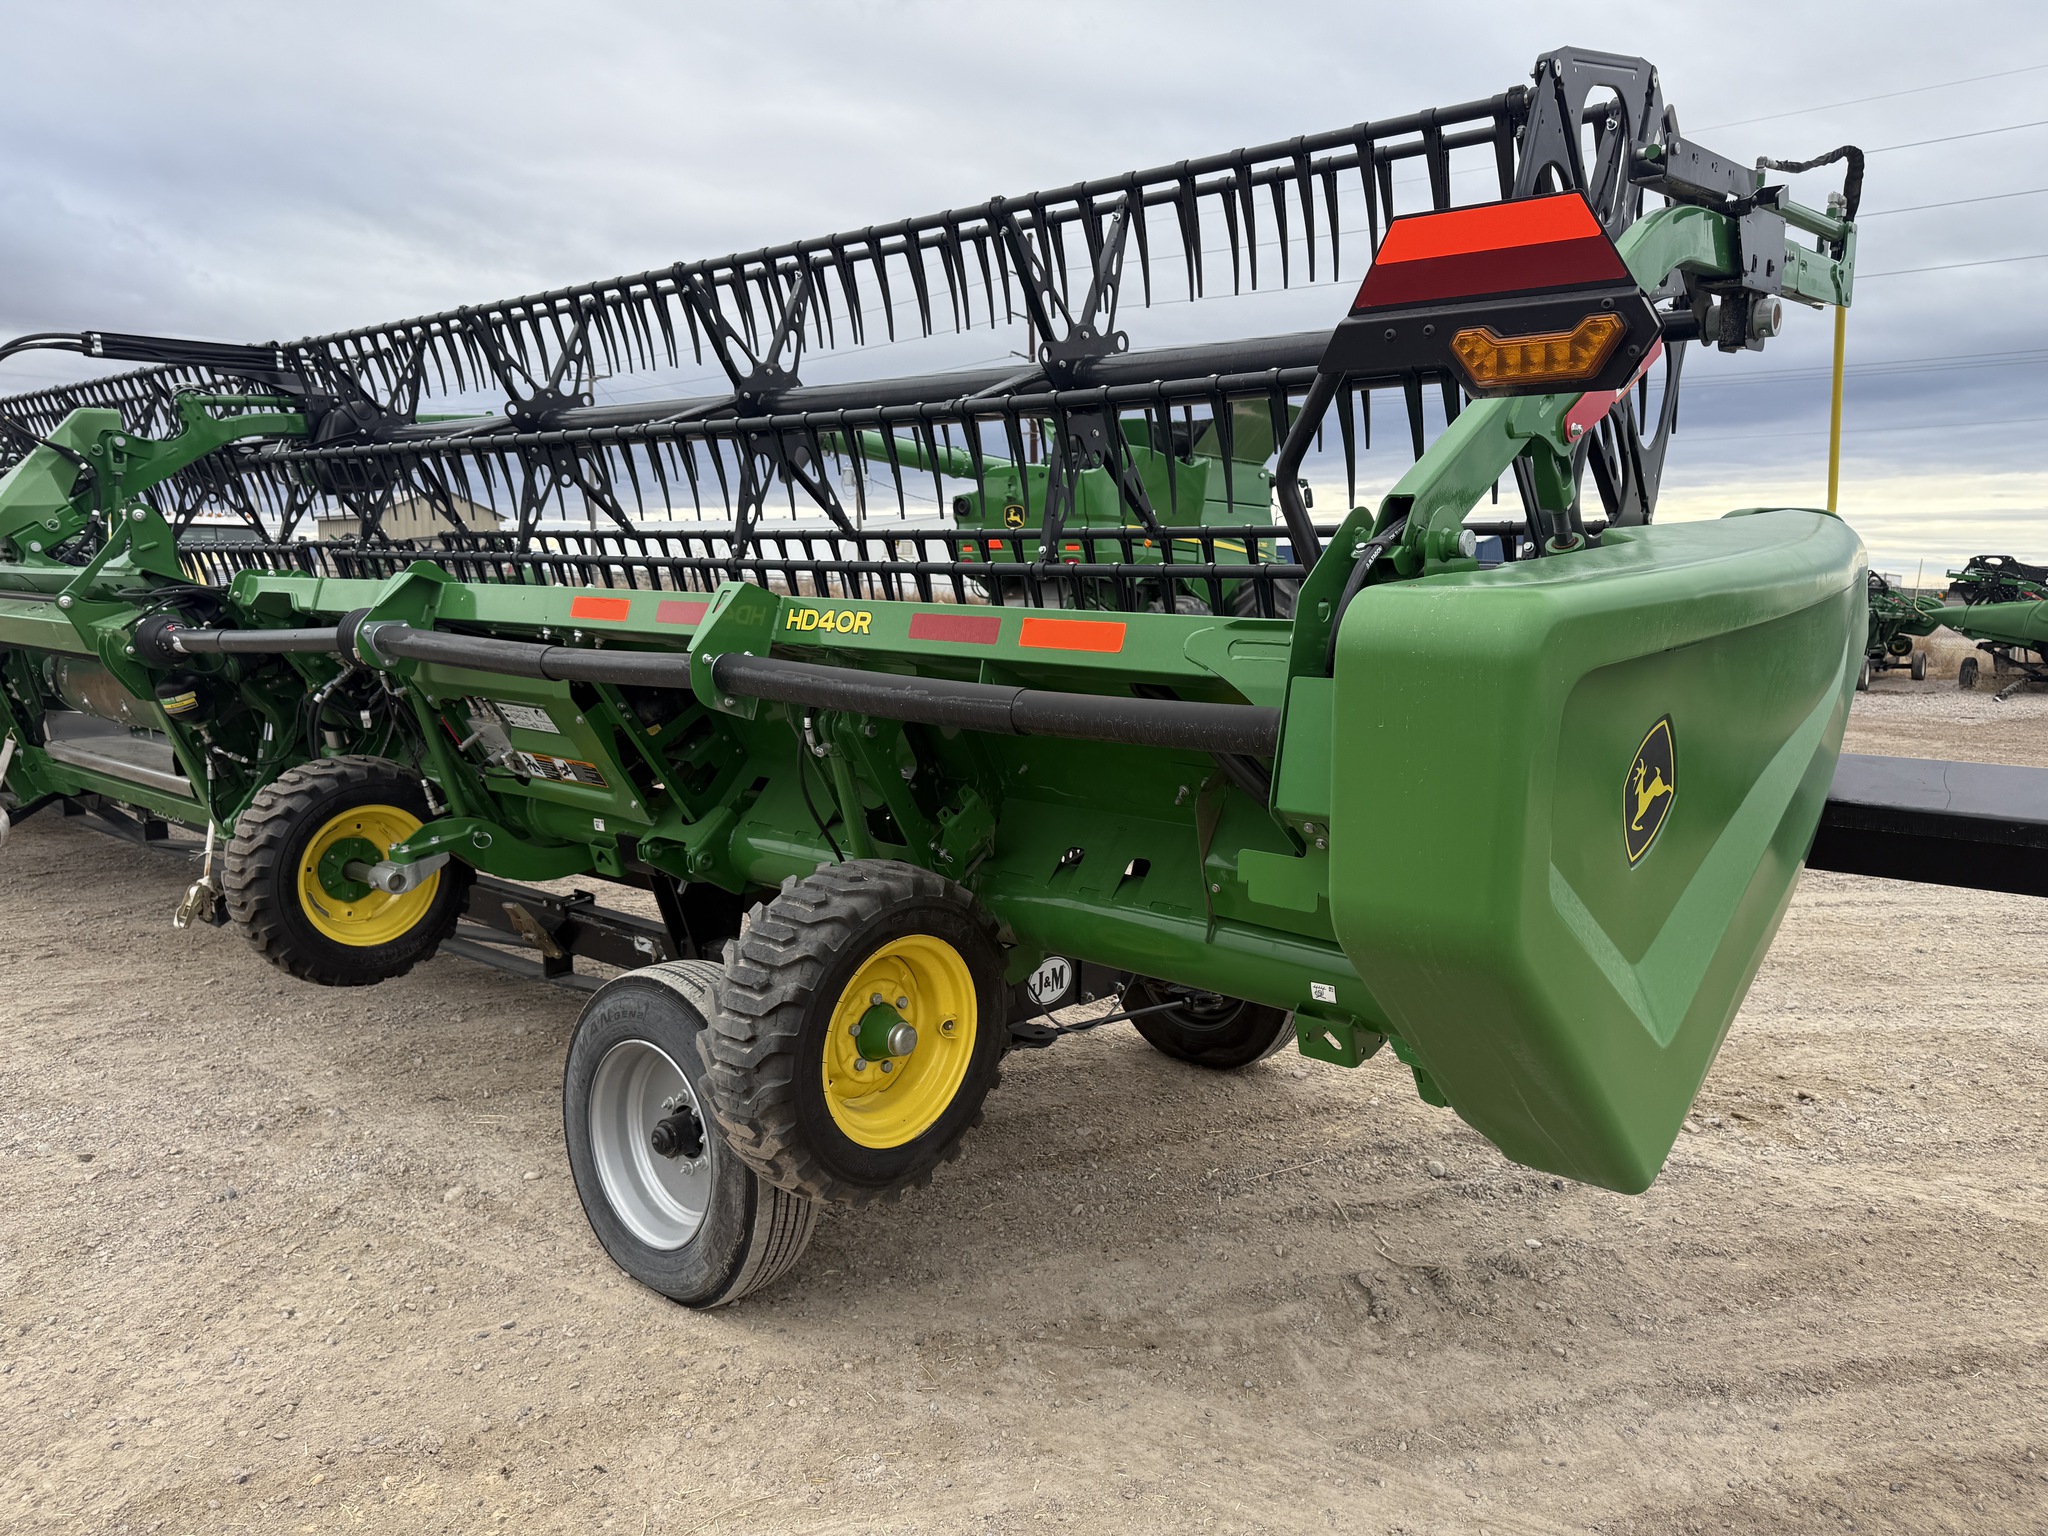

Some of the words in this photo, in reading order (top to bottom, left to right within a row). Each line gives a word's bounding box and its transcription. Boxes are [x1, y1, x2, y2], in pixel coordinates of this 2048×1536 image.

[785, 608, 872, 635] HD40R
[1032, 964, 1066, 997] J&M
[613, 1010, 644, 1021] GEN2
